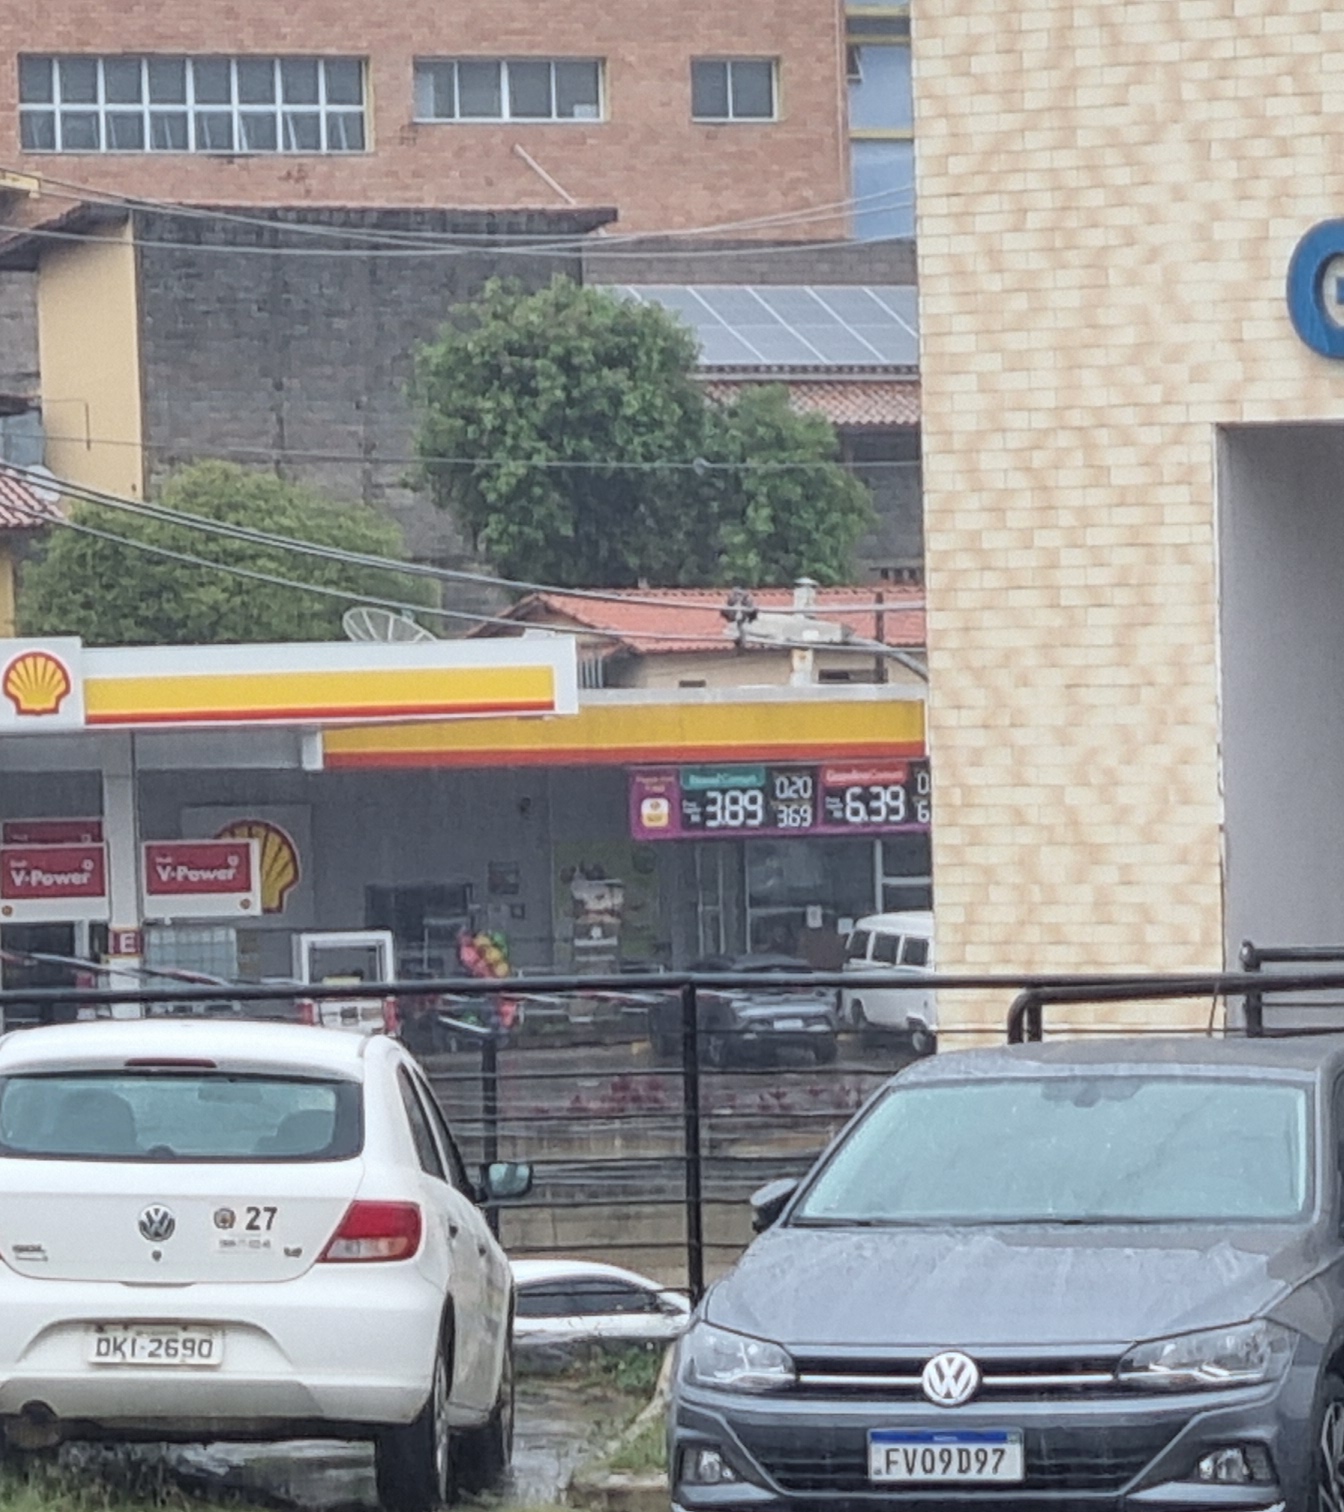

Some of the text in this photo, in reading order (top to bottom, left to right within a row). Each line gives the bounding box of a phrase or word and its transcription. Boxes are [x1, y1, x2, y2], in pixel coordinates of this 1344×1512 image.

[705, 790, 764, 827] 3.89
[845, 786, 905, 822] 6.39
[119, 933, 137, 953] E
[245, 1206, 278, 1231] 27
